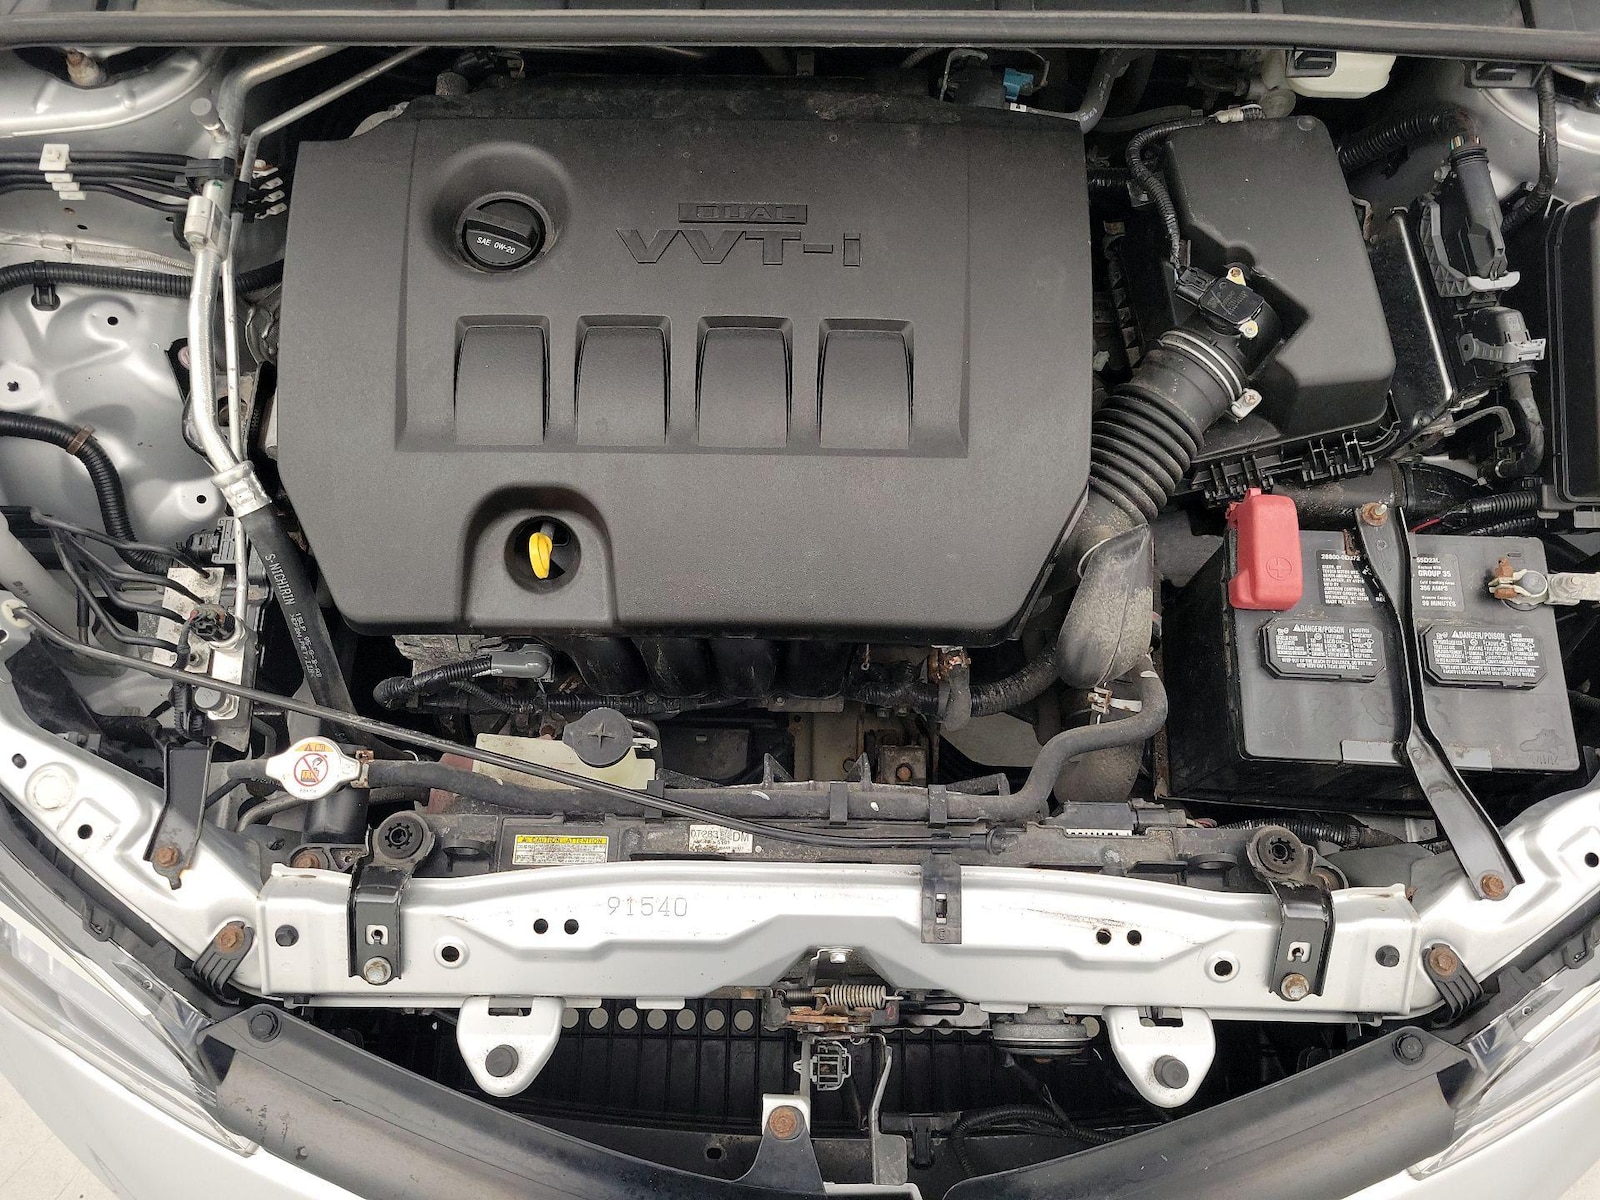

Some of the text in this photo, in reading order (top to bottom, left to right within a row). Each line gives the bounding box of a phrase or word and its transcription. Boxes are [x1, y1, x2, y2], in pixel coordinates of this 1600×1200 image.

[697, 205, 796, 219] DUAL
[476, 236, 516, 255] SAE 0W-20
[1418, 569, 1452, 578] GROUP 35
[607, 896, 687, 917] 91540
